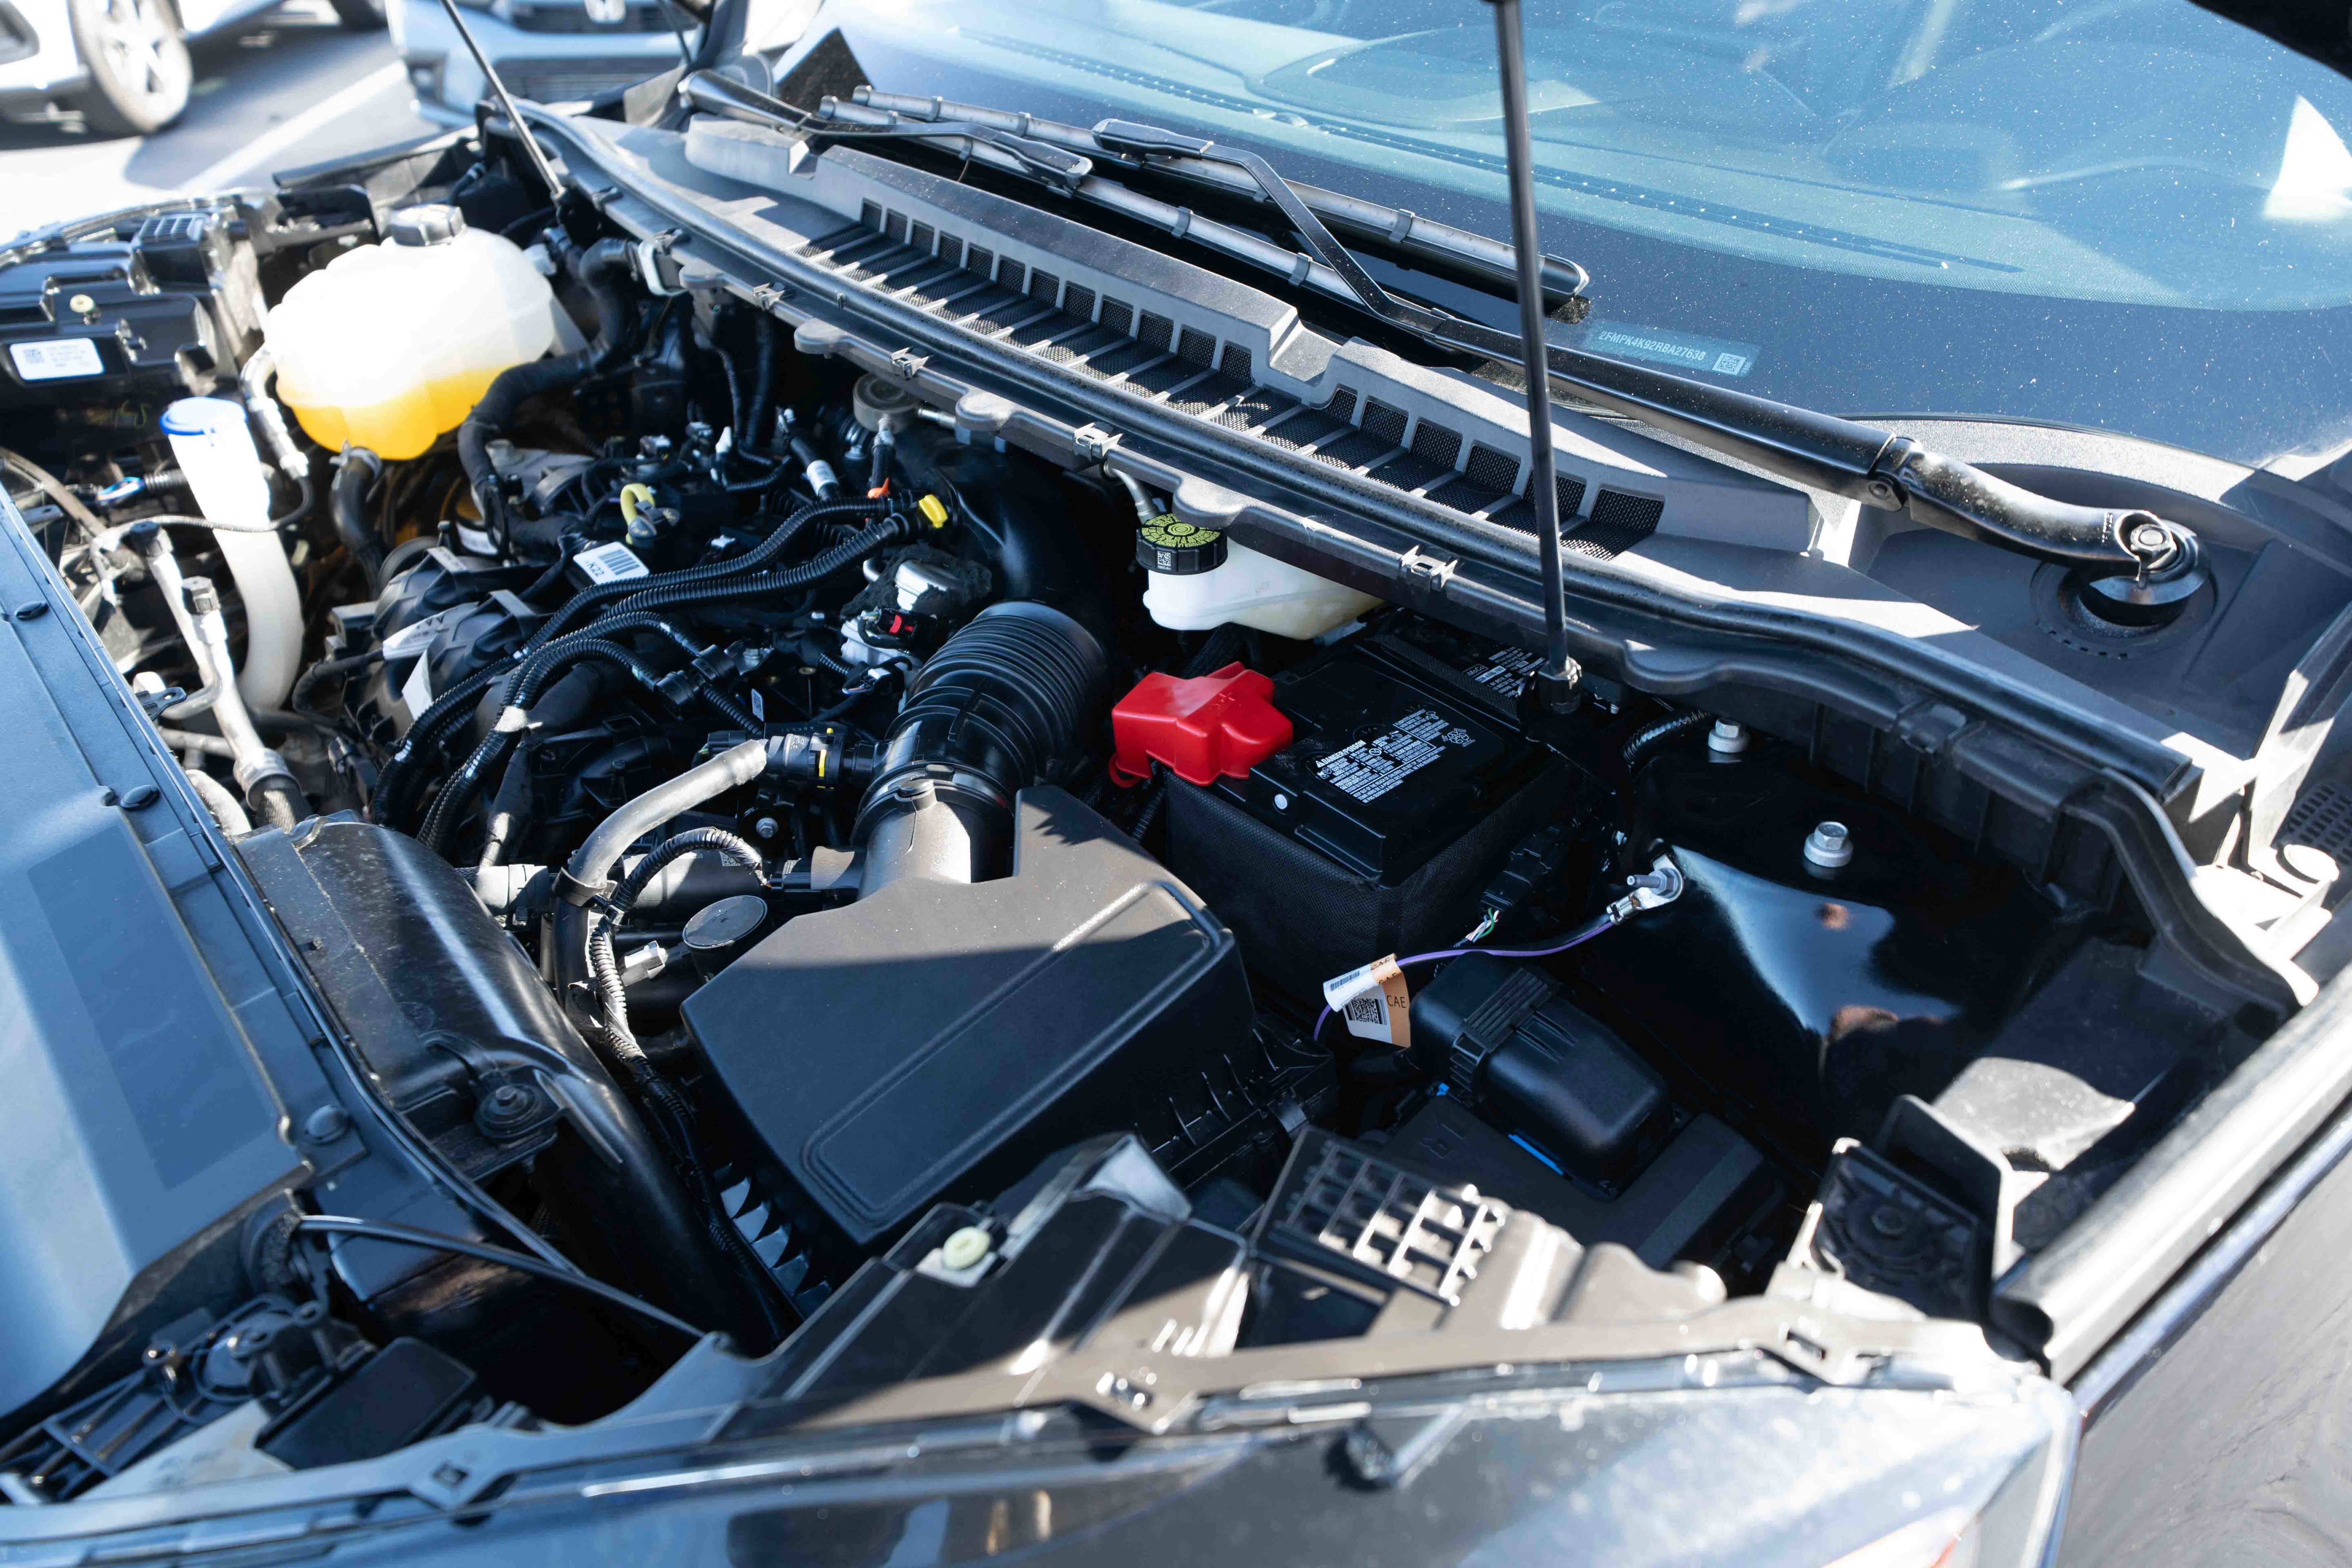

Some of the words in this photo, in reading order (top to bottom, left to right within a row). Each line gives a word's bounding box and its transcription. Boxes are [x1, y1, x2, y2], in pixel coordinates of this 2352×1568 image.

[1598, 331, 1706, 361] 2FMPK4K92RBA27638
[1321, 740, 1366, 765] DANGER/POISON
[1371, 957, 1391, 970] CAE
[1386, 995, 1406, 1008] CAE
